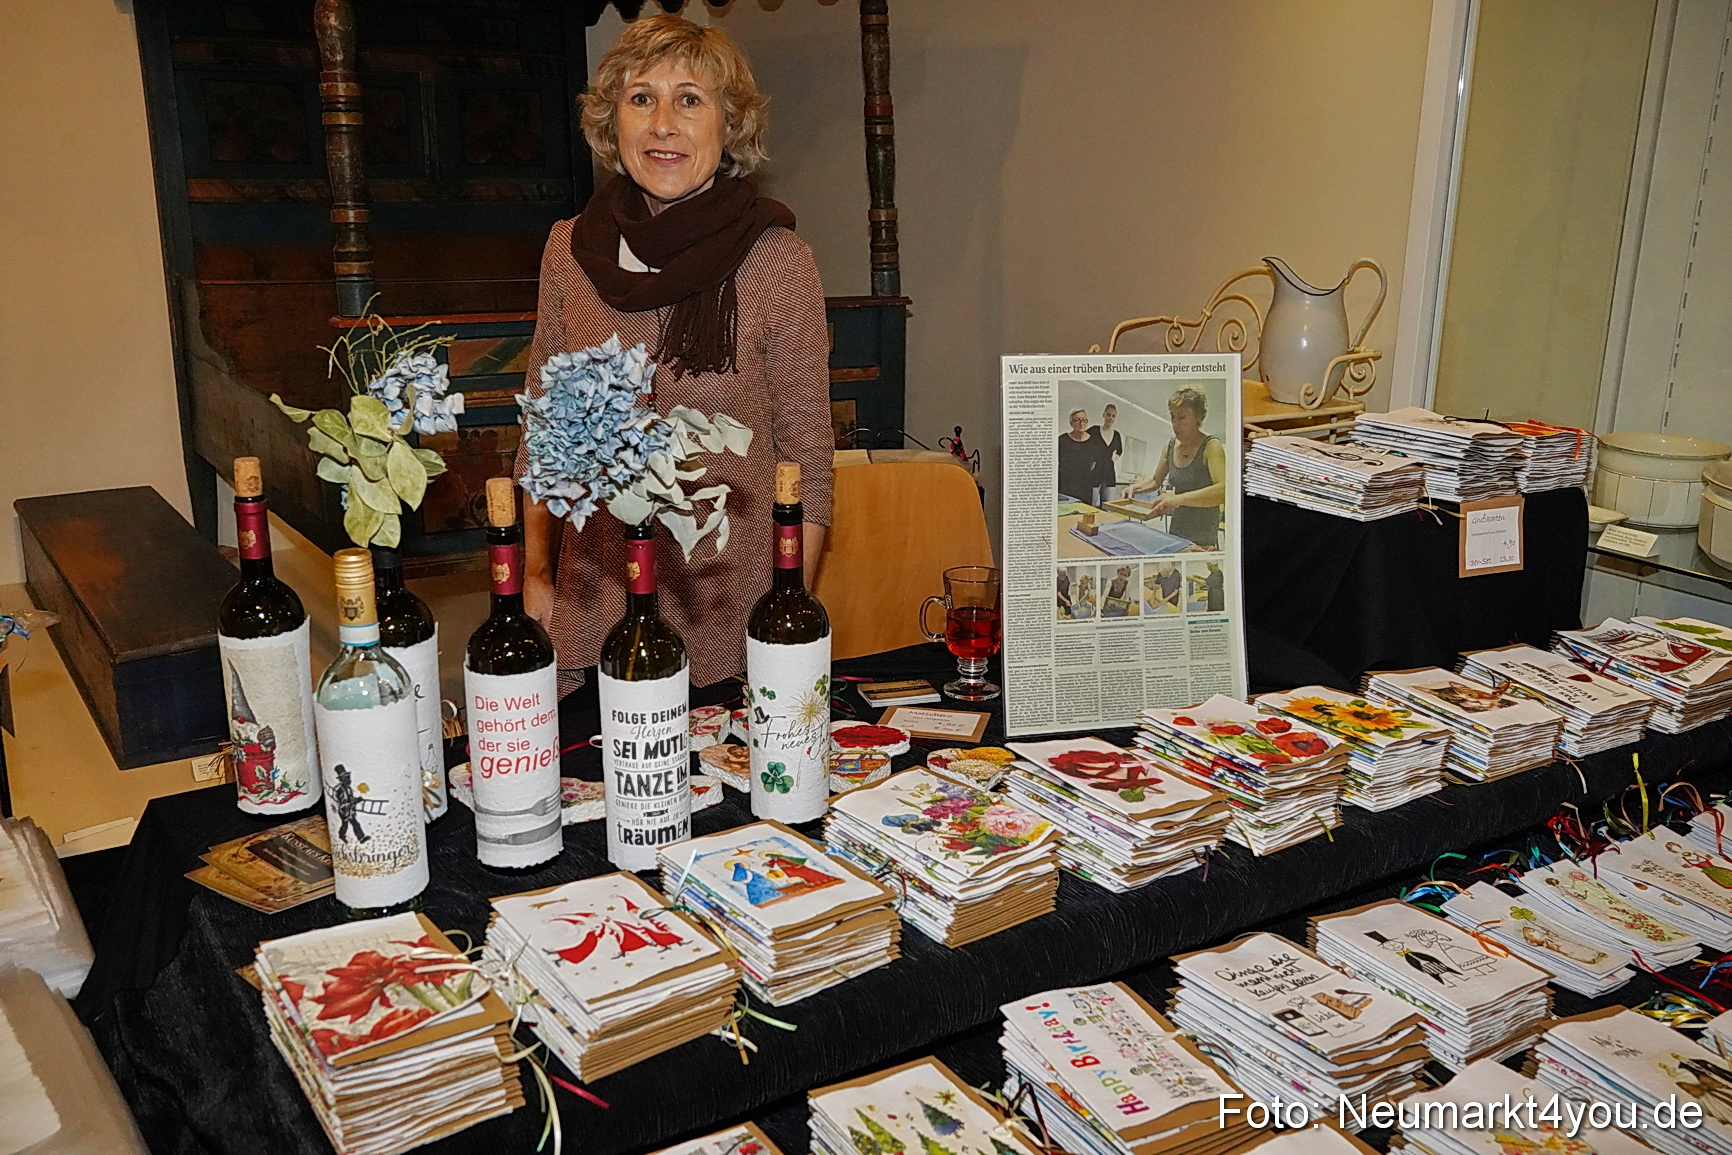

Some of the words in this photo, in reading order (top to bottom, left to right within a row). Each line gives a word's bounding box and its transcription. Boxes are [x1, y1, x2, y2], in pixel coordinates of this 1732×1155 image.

[1008, 364, 1028, 374] Wie
[1030, 366, 1046, 374] aus
[1048, 364, 1071, 373] einer
[1073, 363, 1104, 373] trüben
[1105, 363, 1134, 373] Brühe
[1135, 363, 1161, 373] feines
[1163, 363, 1190, 375] Papier
[1191, 363, 1226, 372] entsteht
[475, 695, 499, 712] Die
[504, 692, 540, 711] Welt
[476, 718, 527, 733] gehört
[531, 709, 557, 727] dem
[612, 709, 647, 724] FOLGE
[630, 725, 674, 740] Herzen
[478, 737, 502, 752] der
[507, 738, 530, 752] sie
[613, 738, 637, 760] SEI
[644, 730, 688, 760] MUTIG
[614, 760, 639, 769] VERTRAUE
[654, 759, 670, 768] DEINE
[614, 770, 674, 798] TANZE
[654, 798, 677, 808] KLEINEN
[632, 818, 644, 826] HÖR
[1268, 953, 1300, 966] die
[1272, 962, 1305, 979] nicht
[1093, 1069, 1150, 1115] Happy
